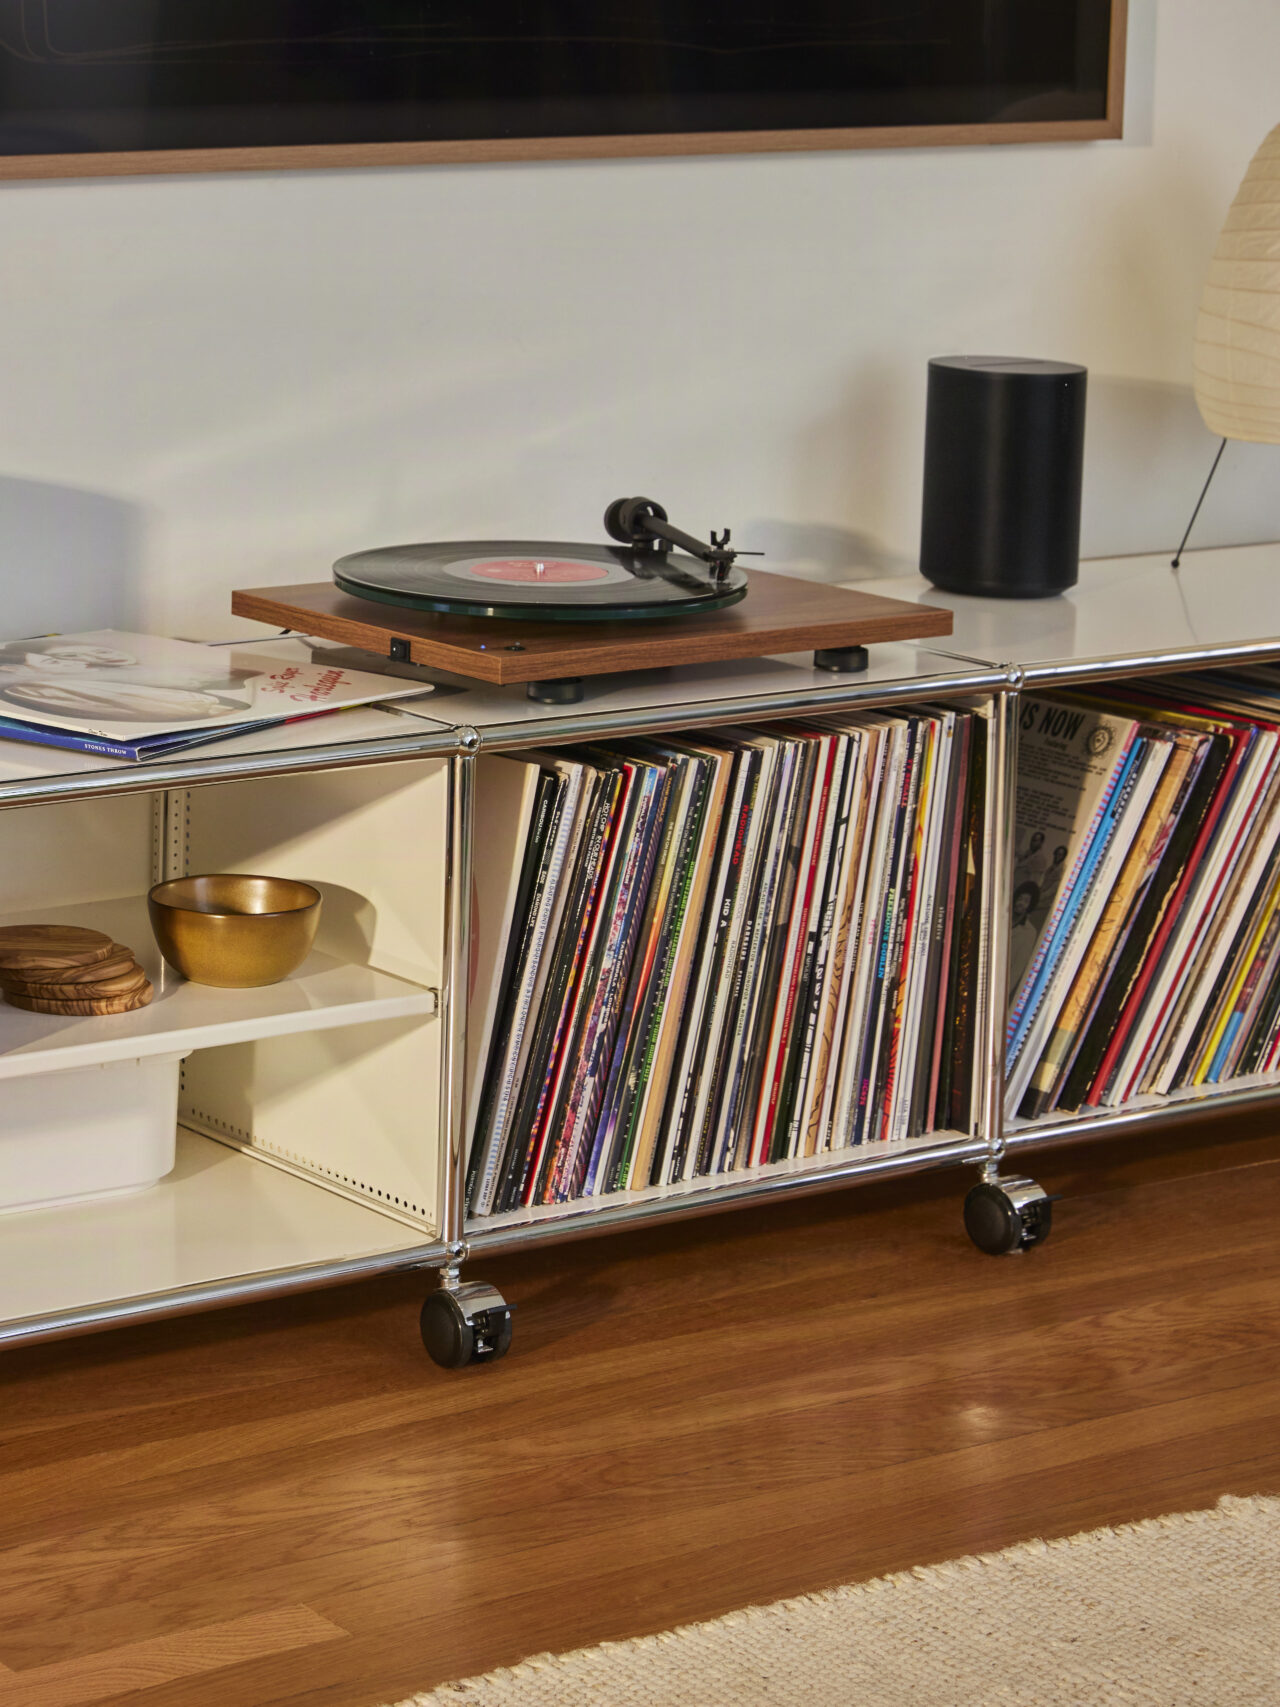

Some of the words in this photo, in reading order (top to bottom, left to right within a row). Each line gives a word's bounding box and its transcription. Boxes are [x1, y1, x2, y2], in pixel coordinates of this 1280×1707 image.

[1037, 707, 1086, 741] NOW
[84, 743, 106, 752] STONES
[107, 747, 127, 755] THROW
[905, 758, 913, 769] TY
[899, 770, 912, 809] SEGALL
[537, 799, 548, 827] CARIBOU
[601, 801, 611, 817] HOT
[657, 795, 668, 822] IMPALA
[598, 816, 607, 832] CHIP
[682, 829, 689, 839] ON
[684, 817, 692, 830] WAR
[730, 803, 749, 865] RADIOHEAD
[595, 834, 603, 843] IN
[663, 841, 669, 849] ON
[678, 838, 687, 857] DRUGS
[591, 843, 601, 858] OUR
[538, 870, 546, 884] SADE
[586, 857, 597, 880] HEADS
[686, 860, 695, 877] KING
[670, 871, 679, 892] DEEPER
[679, 878, 691, 909] GIZZARD
[759, 882, 768, 904] ARCADE
[531, 892, 542, 916] DIAMOND
[661, 892, 675, 936] UNDERSTANDING
[721, 897, 732, 916] KID
[756, 906, 764, 920] FIRE
[881, 887, 896, 941] FREEDOM'S
[675, 917, 683, 931] THE
[719, 919, 728, 928] A
[934, 905, 946, 941] slowdive
[617, 940, 626, 959] TAME
[669, 931, 680, 957] LIZARD
[739, 919, 752, 961] DARKSIDE
[749, 927, 760, 962] REFLEKTOR
[723, 939, 736, 979] RADIOHEAD
[876, 941, 888, 979] GOBLIN
[611, 960, 621, 986] IMPALA
[662, 958, 674, 987] WIZARD
[650, 1023, 660, 1043] YOUR
